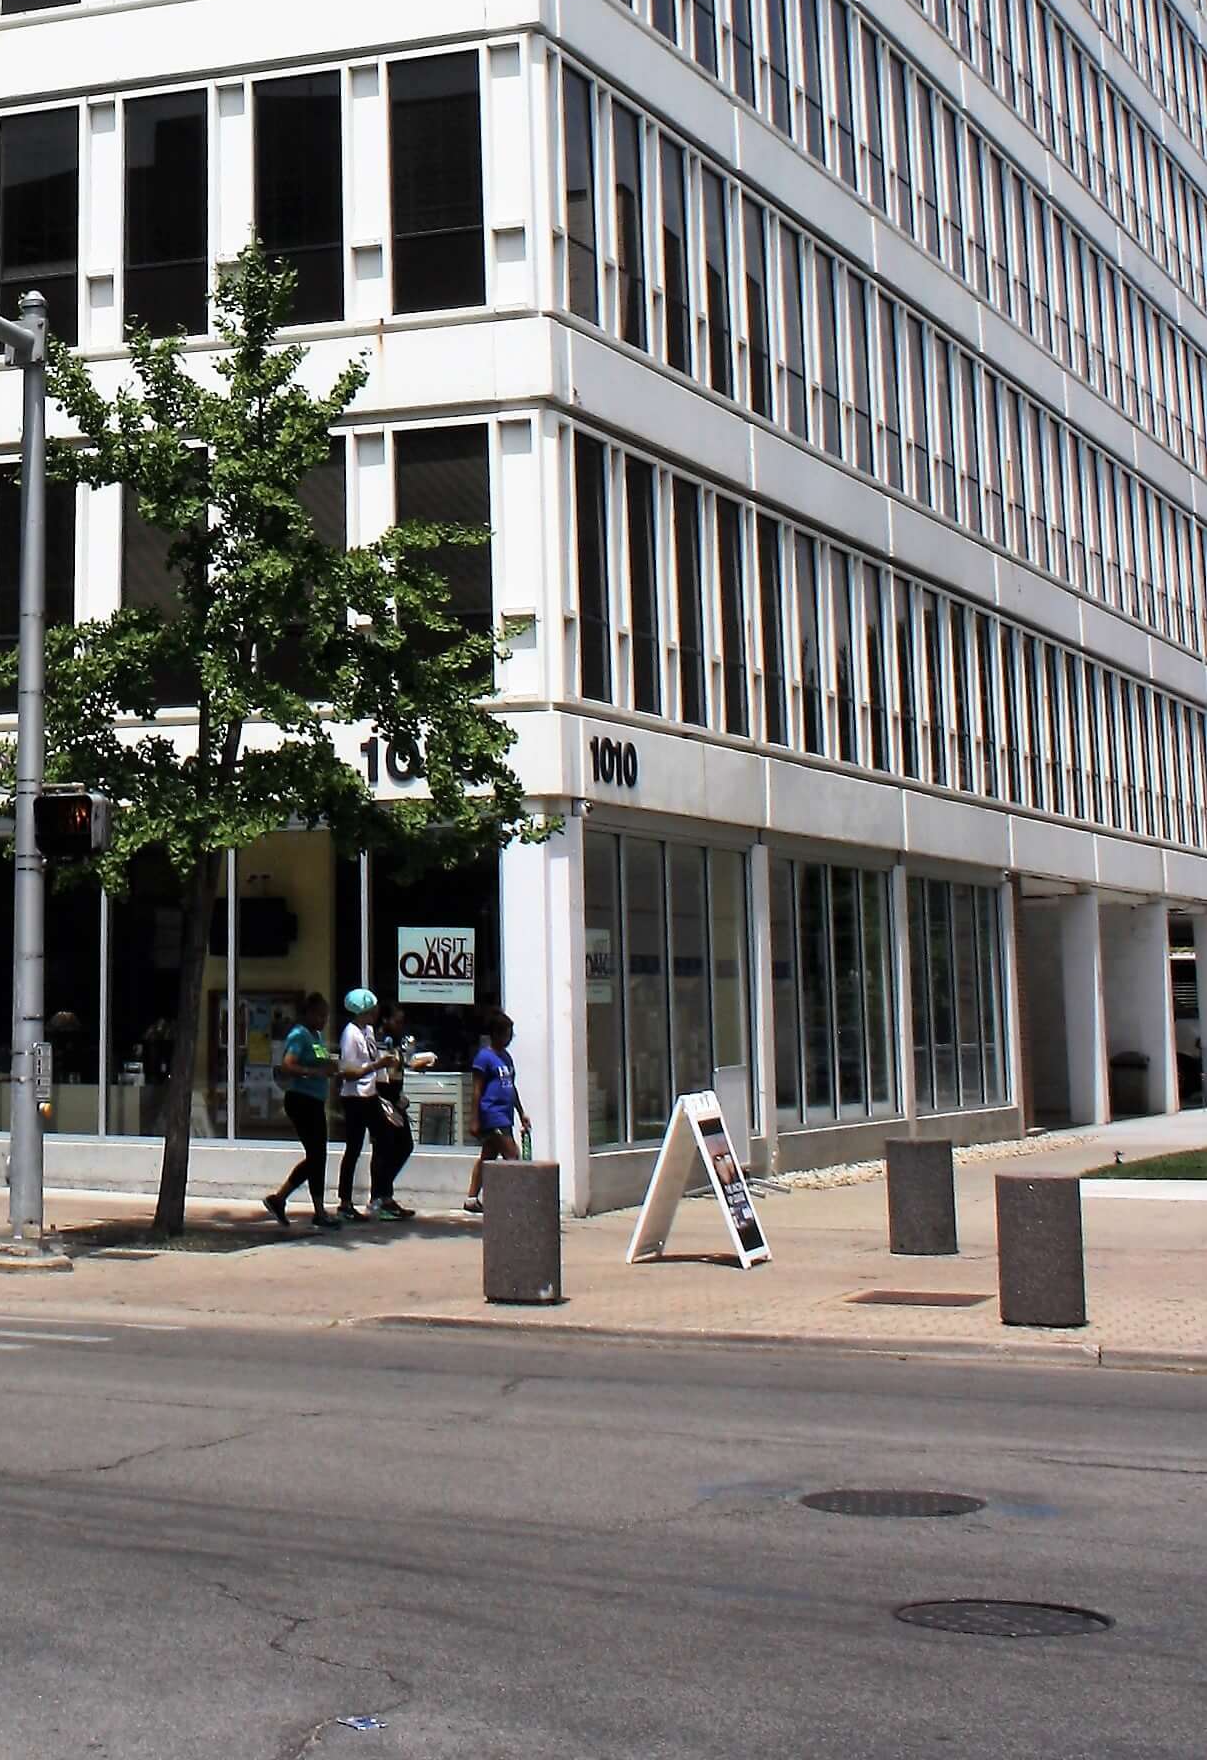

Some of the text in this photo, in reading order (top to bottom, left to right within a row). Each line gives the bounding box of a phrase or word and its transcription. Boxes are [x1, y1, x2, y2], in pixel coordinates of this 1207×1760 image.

[590, 736, 638, 788] 1010
[424, 936, 467, 953] VISIT
[400, 951, 466, 979] OAK
